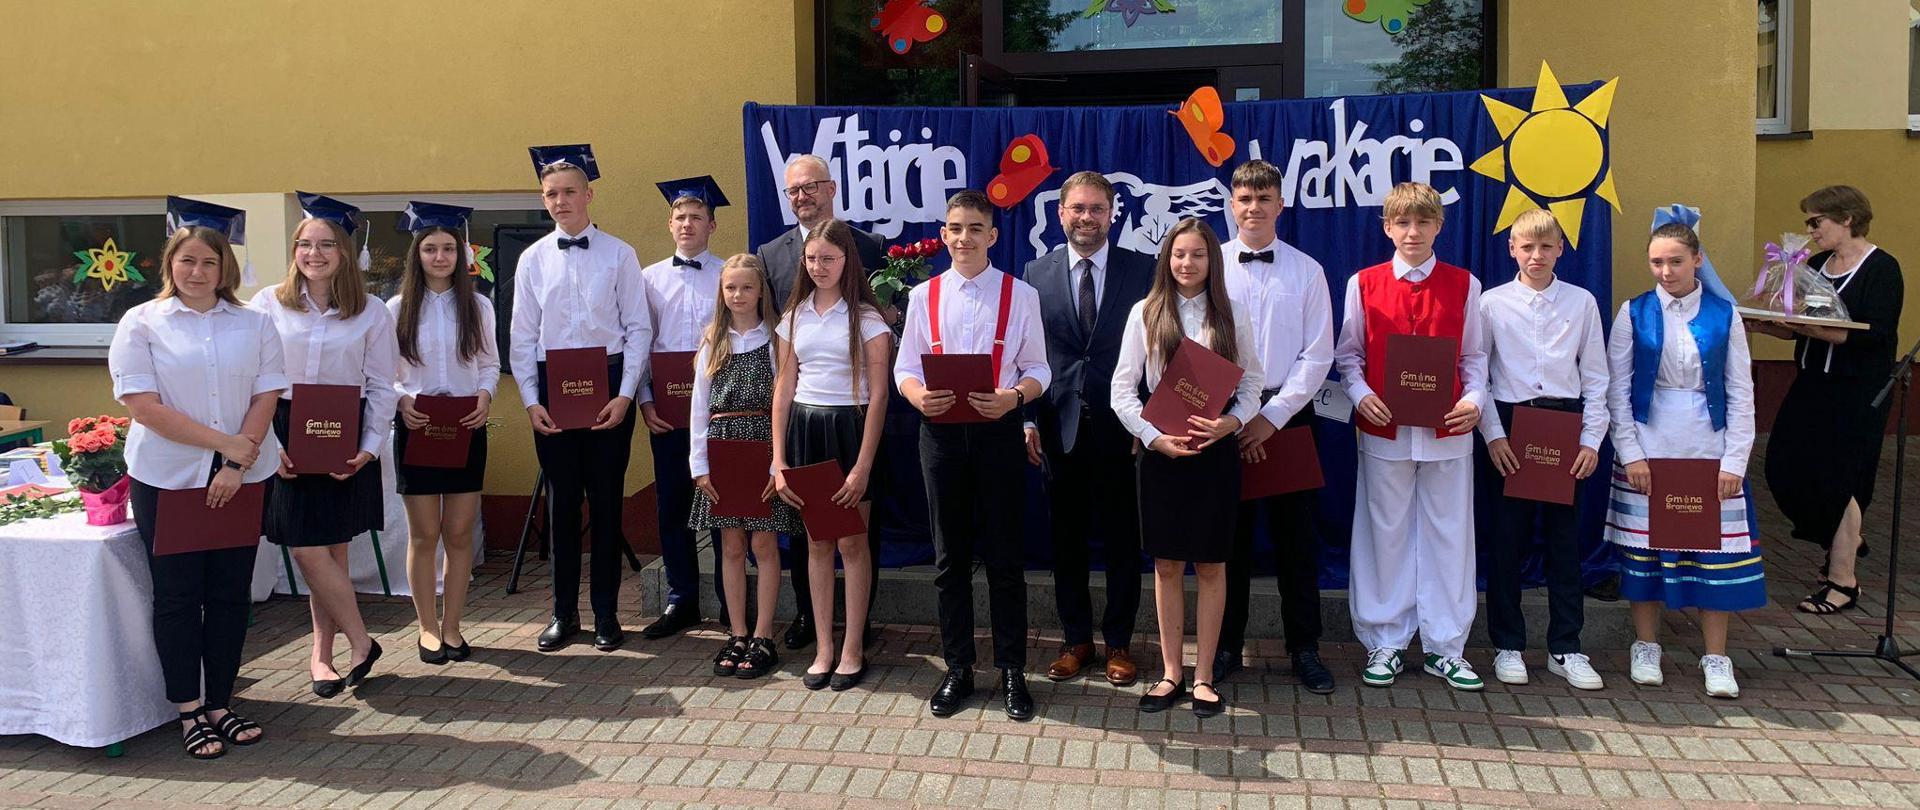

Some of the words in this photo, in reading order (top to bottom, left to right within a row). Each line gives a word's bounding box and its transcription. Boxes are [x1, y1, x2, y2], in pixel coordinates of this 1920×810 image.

[1400, 380, 1437, 389] Braniewo
[306, 427, 342, 436] Braniewo
[1524, 451, 1561, 463] Braniewo
[1665, 502, 1703, 511] Braniewo
